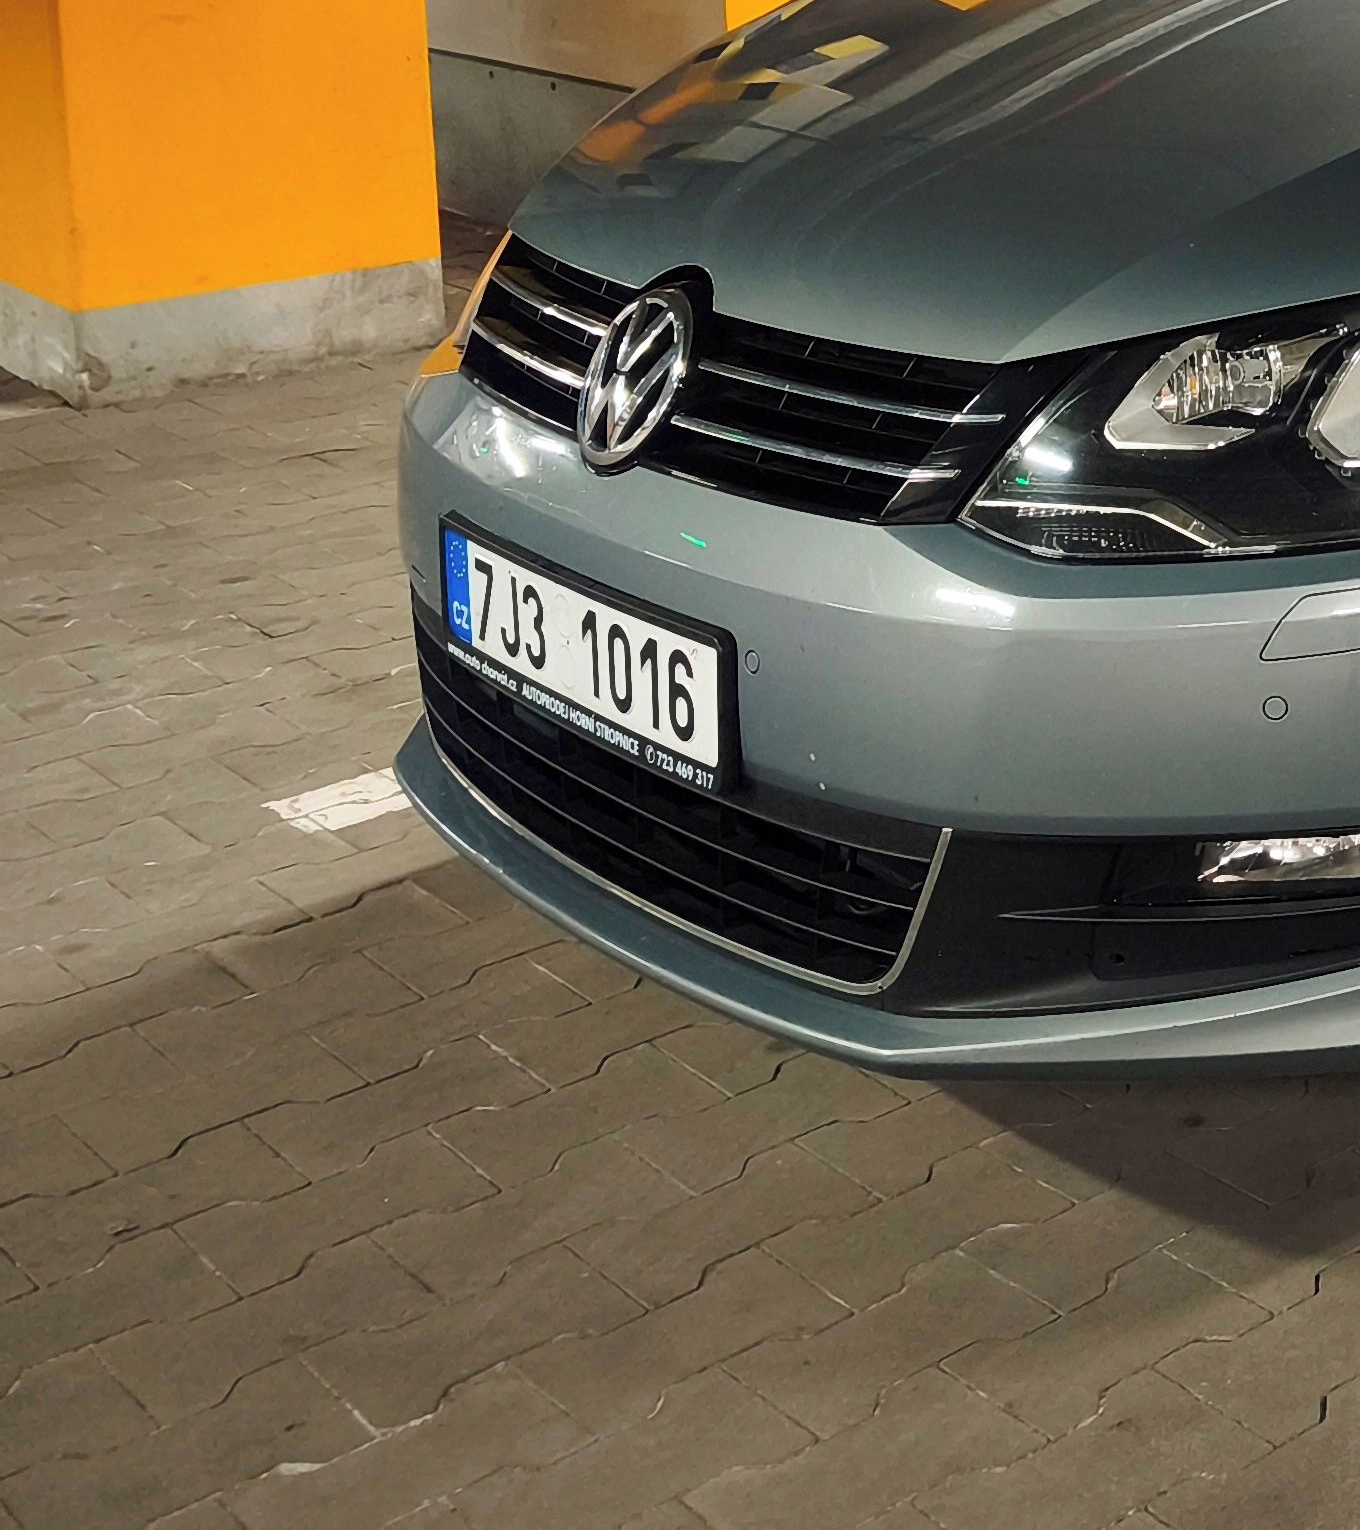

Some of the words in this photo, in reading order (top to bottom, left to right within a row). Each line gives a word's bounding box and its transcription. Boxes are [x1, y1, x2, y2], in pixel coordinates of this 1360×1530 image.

[452, 600, 470, 630] CZ
[474, 556, 546, 670] 7J3
[581, 609, 695, 742] 1016
[521, 682, 569, 720] AUTOPRODEJ
[656, 750, 674, 773] 723
[675, 760, 694, 781] 469
[695, 768, 714, 790] 317
